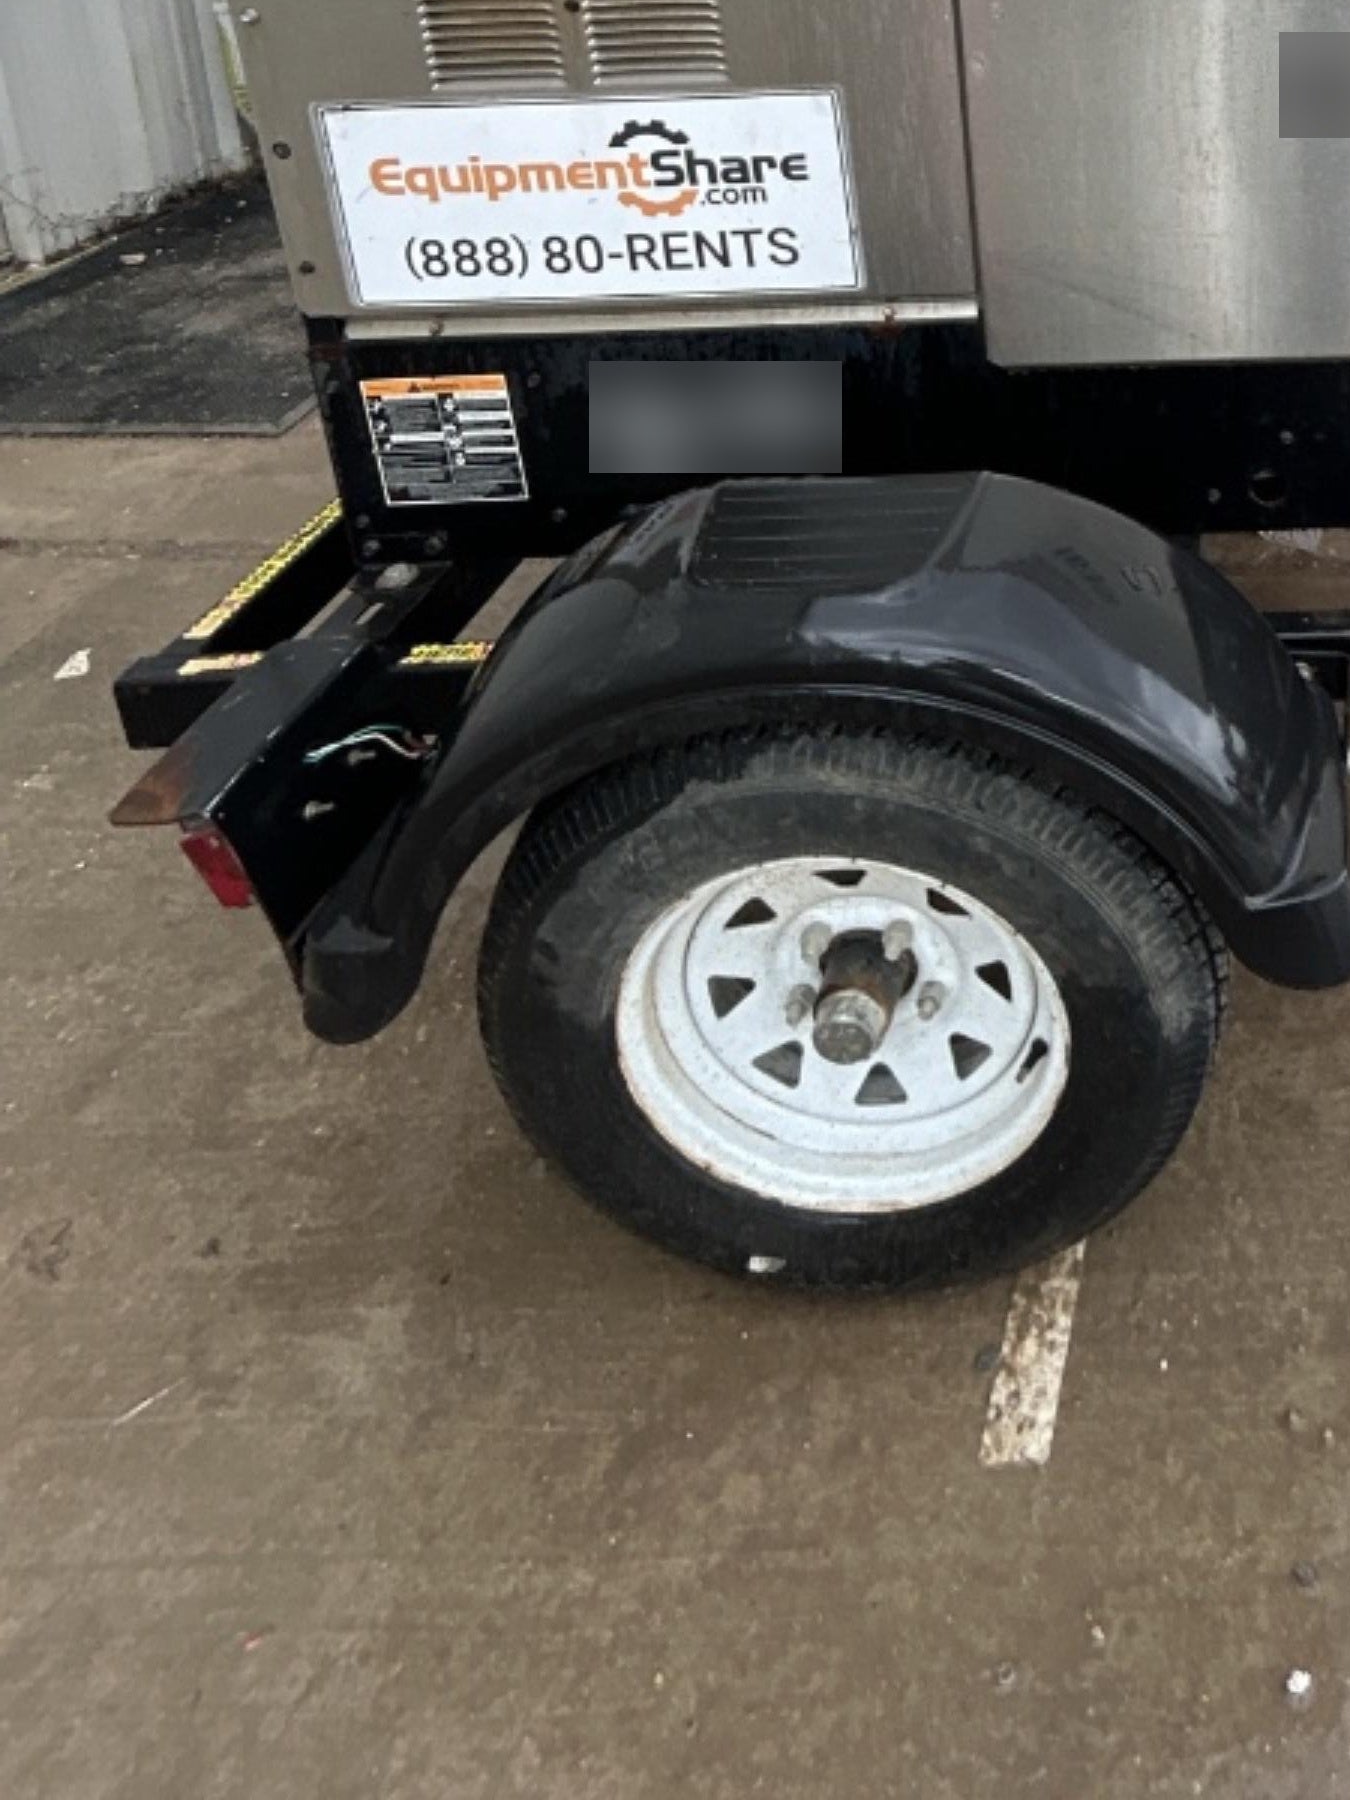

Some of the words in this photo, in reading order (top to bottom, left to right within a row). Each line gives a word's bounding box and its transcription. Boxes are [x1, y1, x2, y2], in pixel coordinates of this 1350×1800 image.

[368, 149, 809, 201] EquipmentShare
[404, 233, 529, 281] (888)
[543, 227, 800, 274] 80-RENTS
